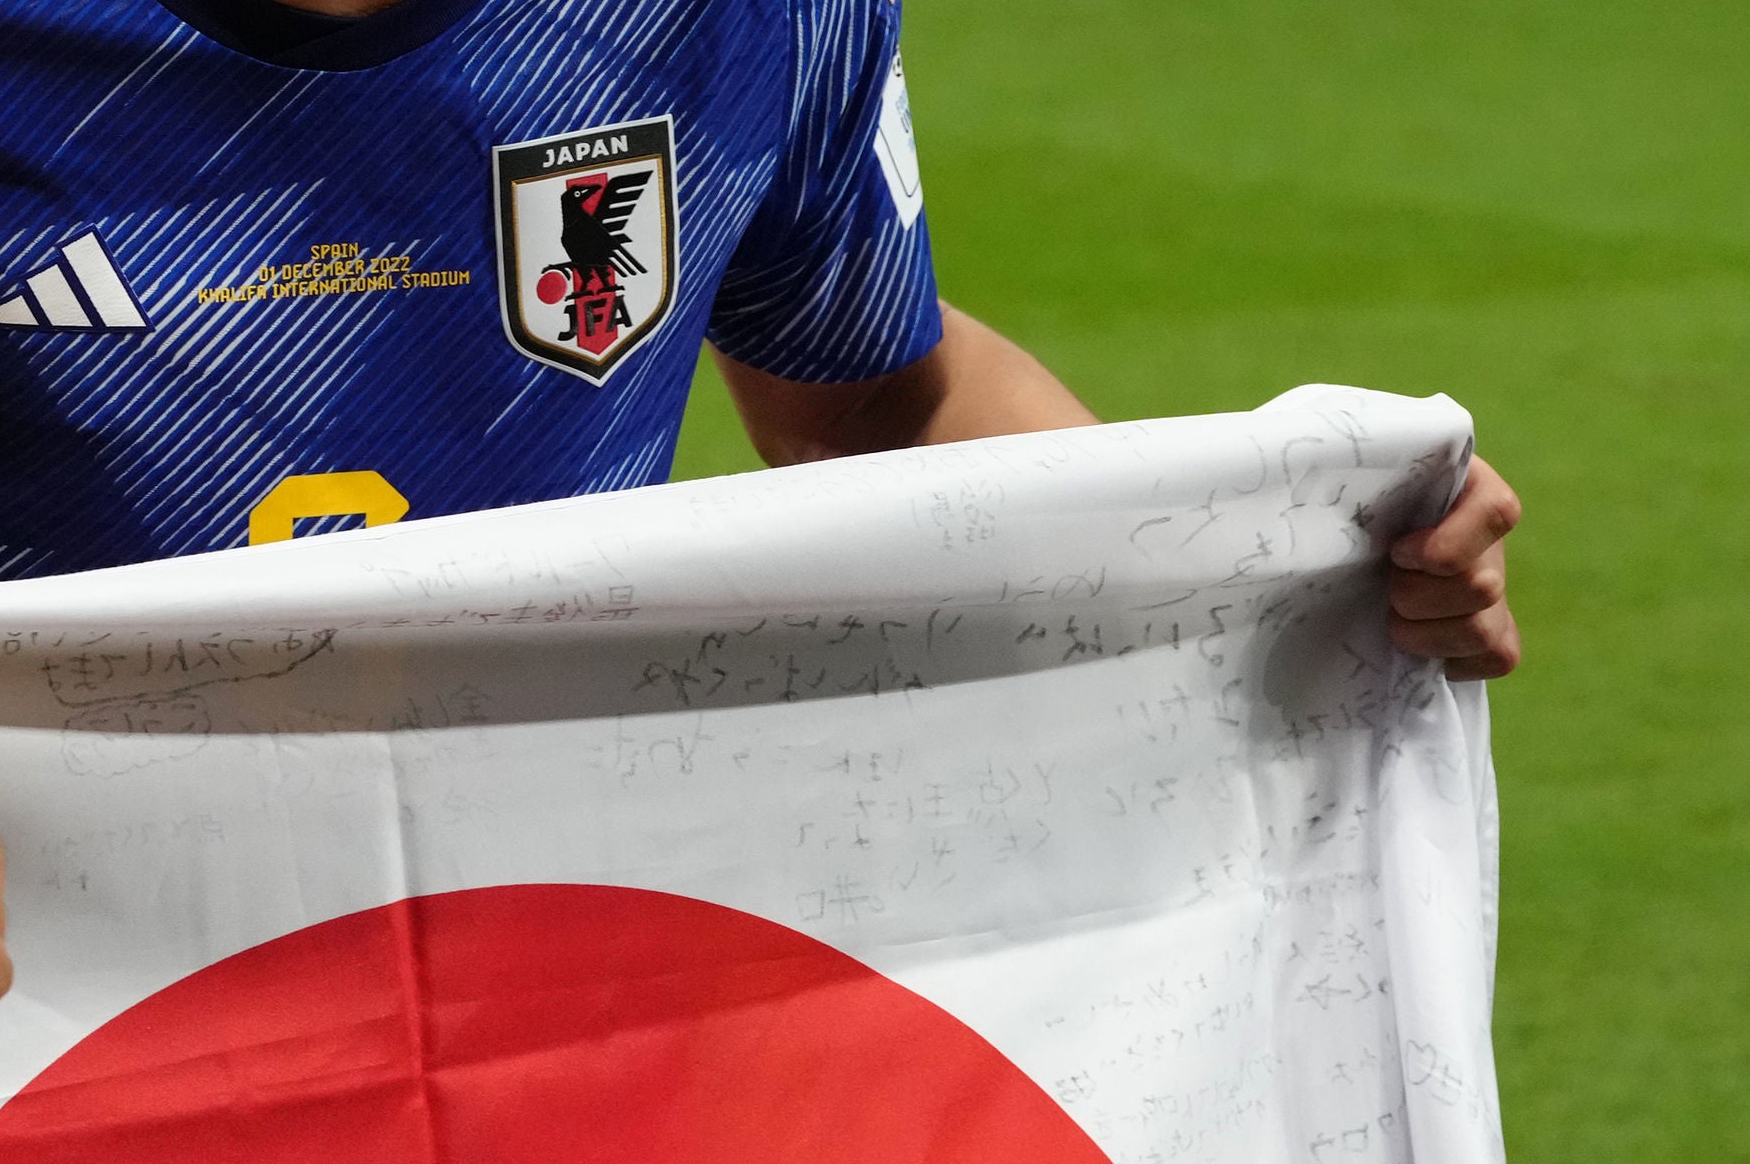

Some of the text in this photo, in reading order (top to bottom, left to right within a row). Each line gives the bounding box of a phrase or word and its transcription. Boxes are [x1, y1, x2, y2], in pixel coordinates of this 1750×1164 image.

[542, 135, 629, 168] JAPAN
[311, 242, 359, 260] SPAIN
[259, 256, 410, 282] 01 DECEMBER 2022
[198, 270, 470, 304] KHALIFA INTERNATIONAL STADIUM
[558, 296, 632, 341] JFA
